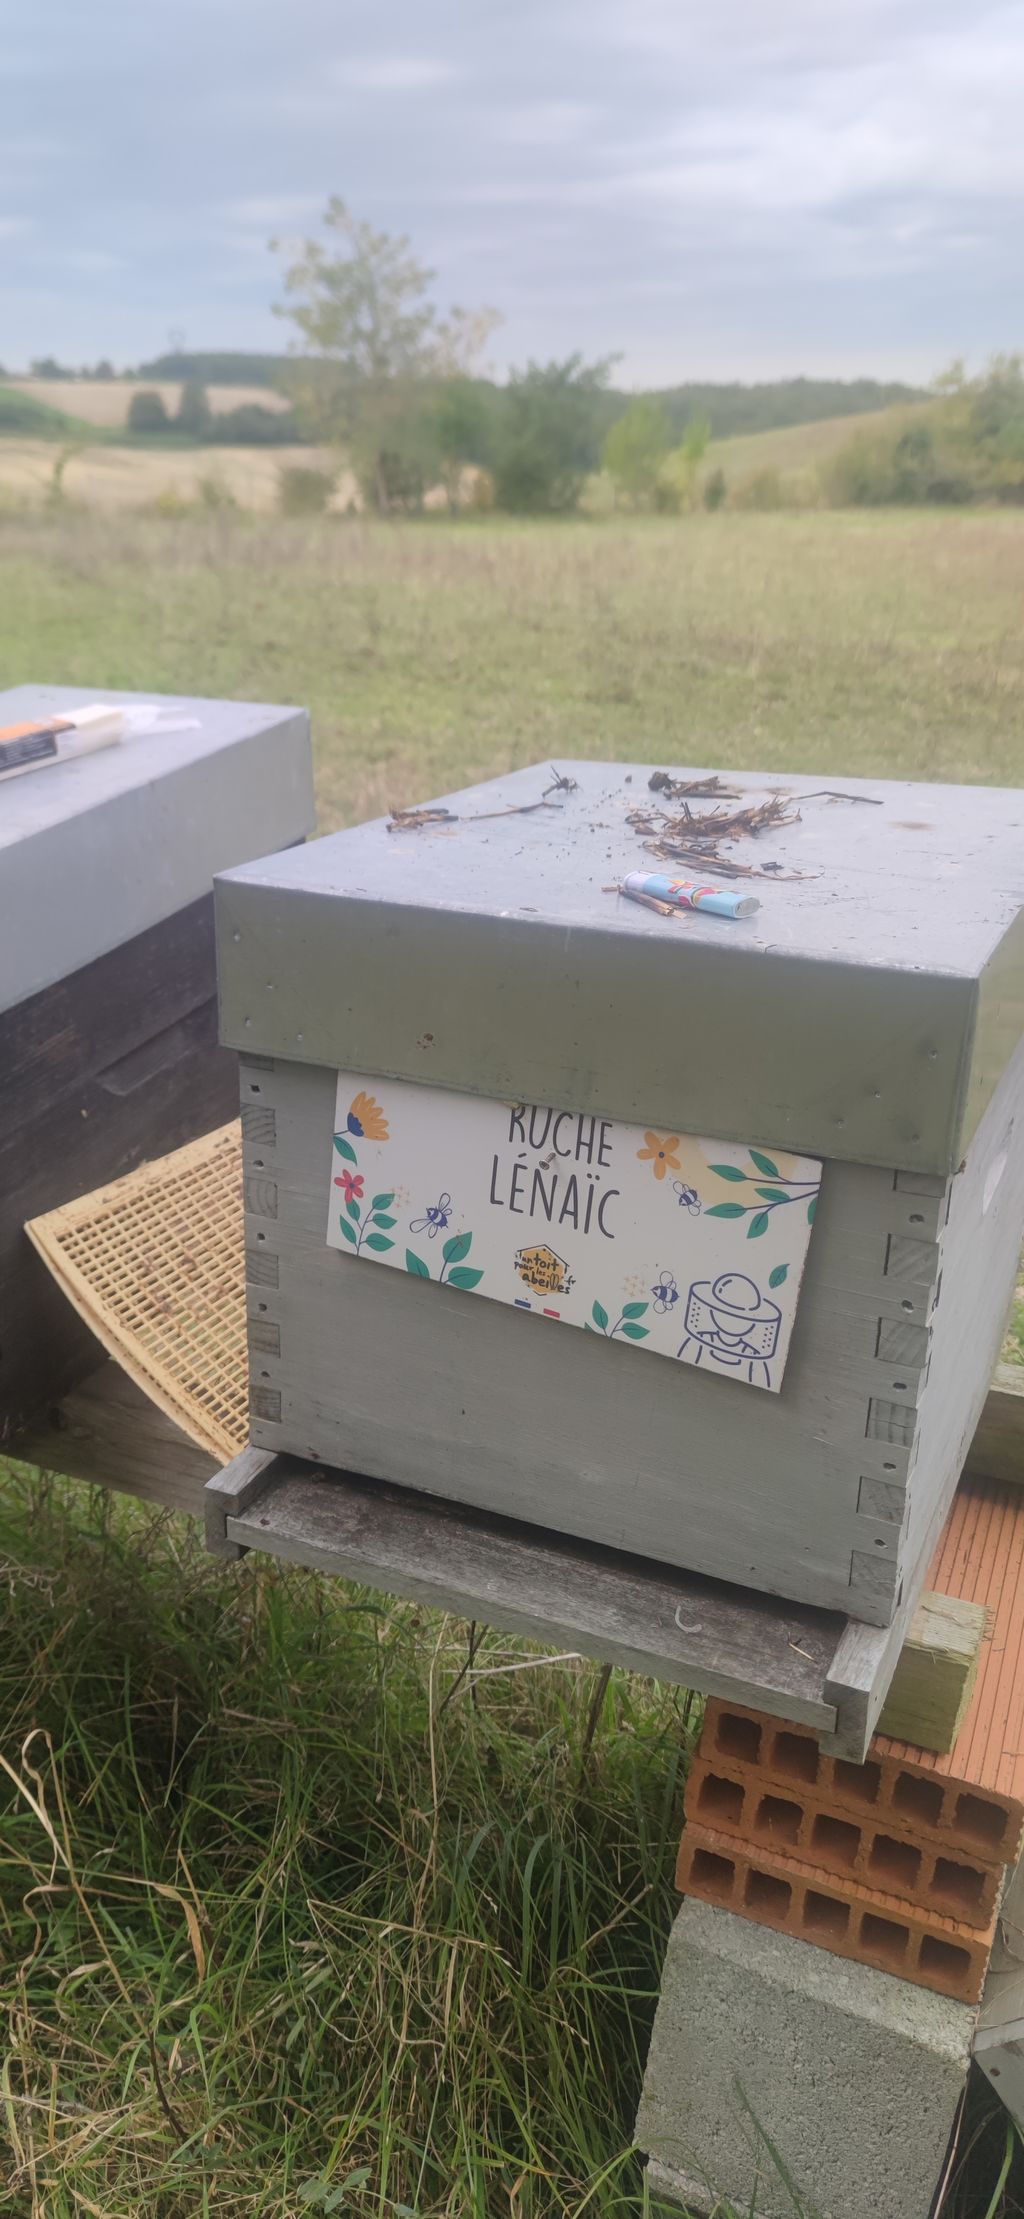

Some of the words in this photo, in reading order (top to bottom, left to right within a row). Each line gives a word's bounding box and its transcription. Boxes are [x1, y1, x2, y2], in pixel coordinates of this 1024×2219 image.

[508, 1105, 613, 1167] RUCHE
[490, 1152, 621, 1239] LÉNAÏC
[522, 1271, 571, 1294] abeilles
[533, 1253, 559, 1271] toit
